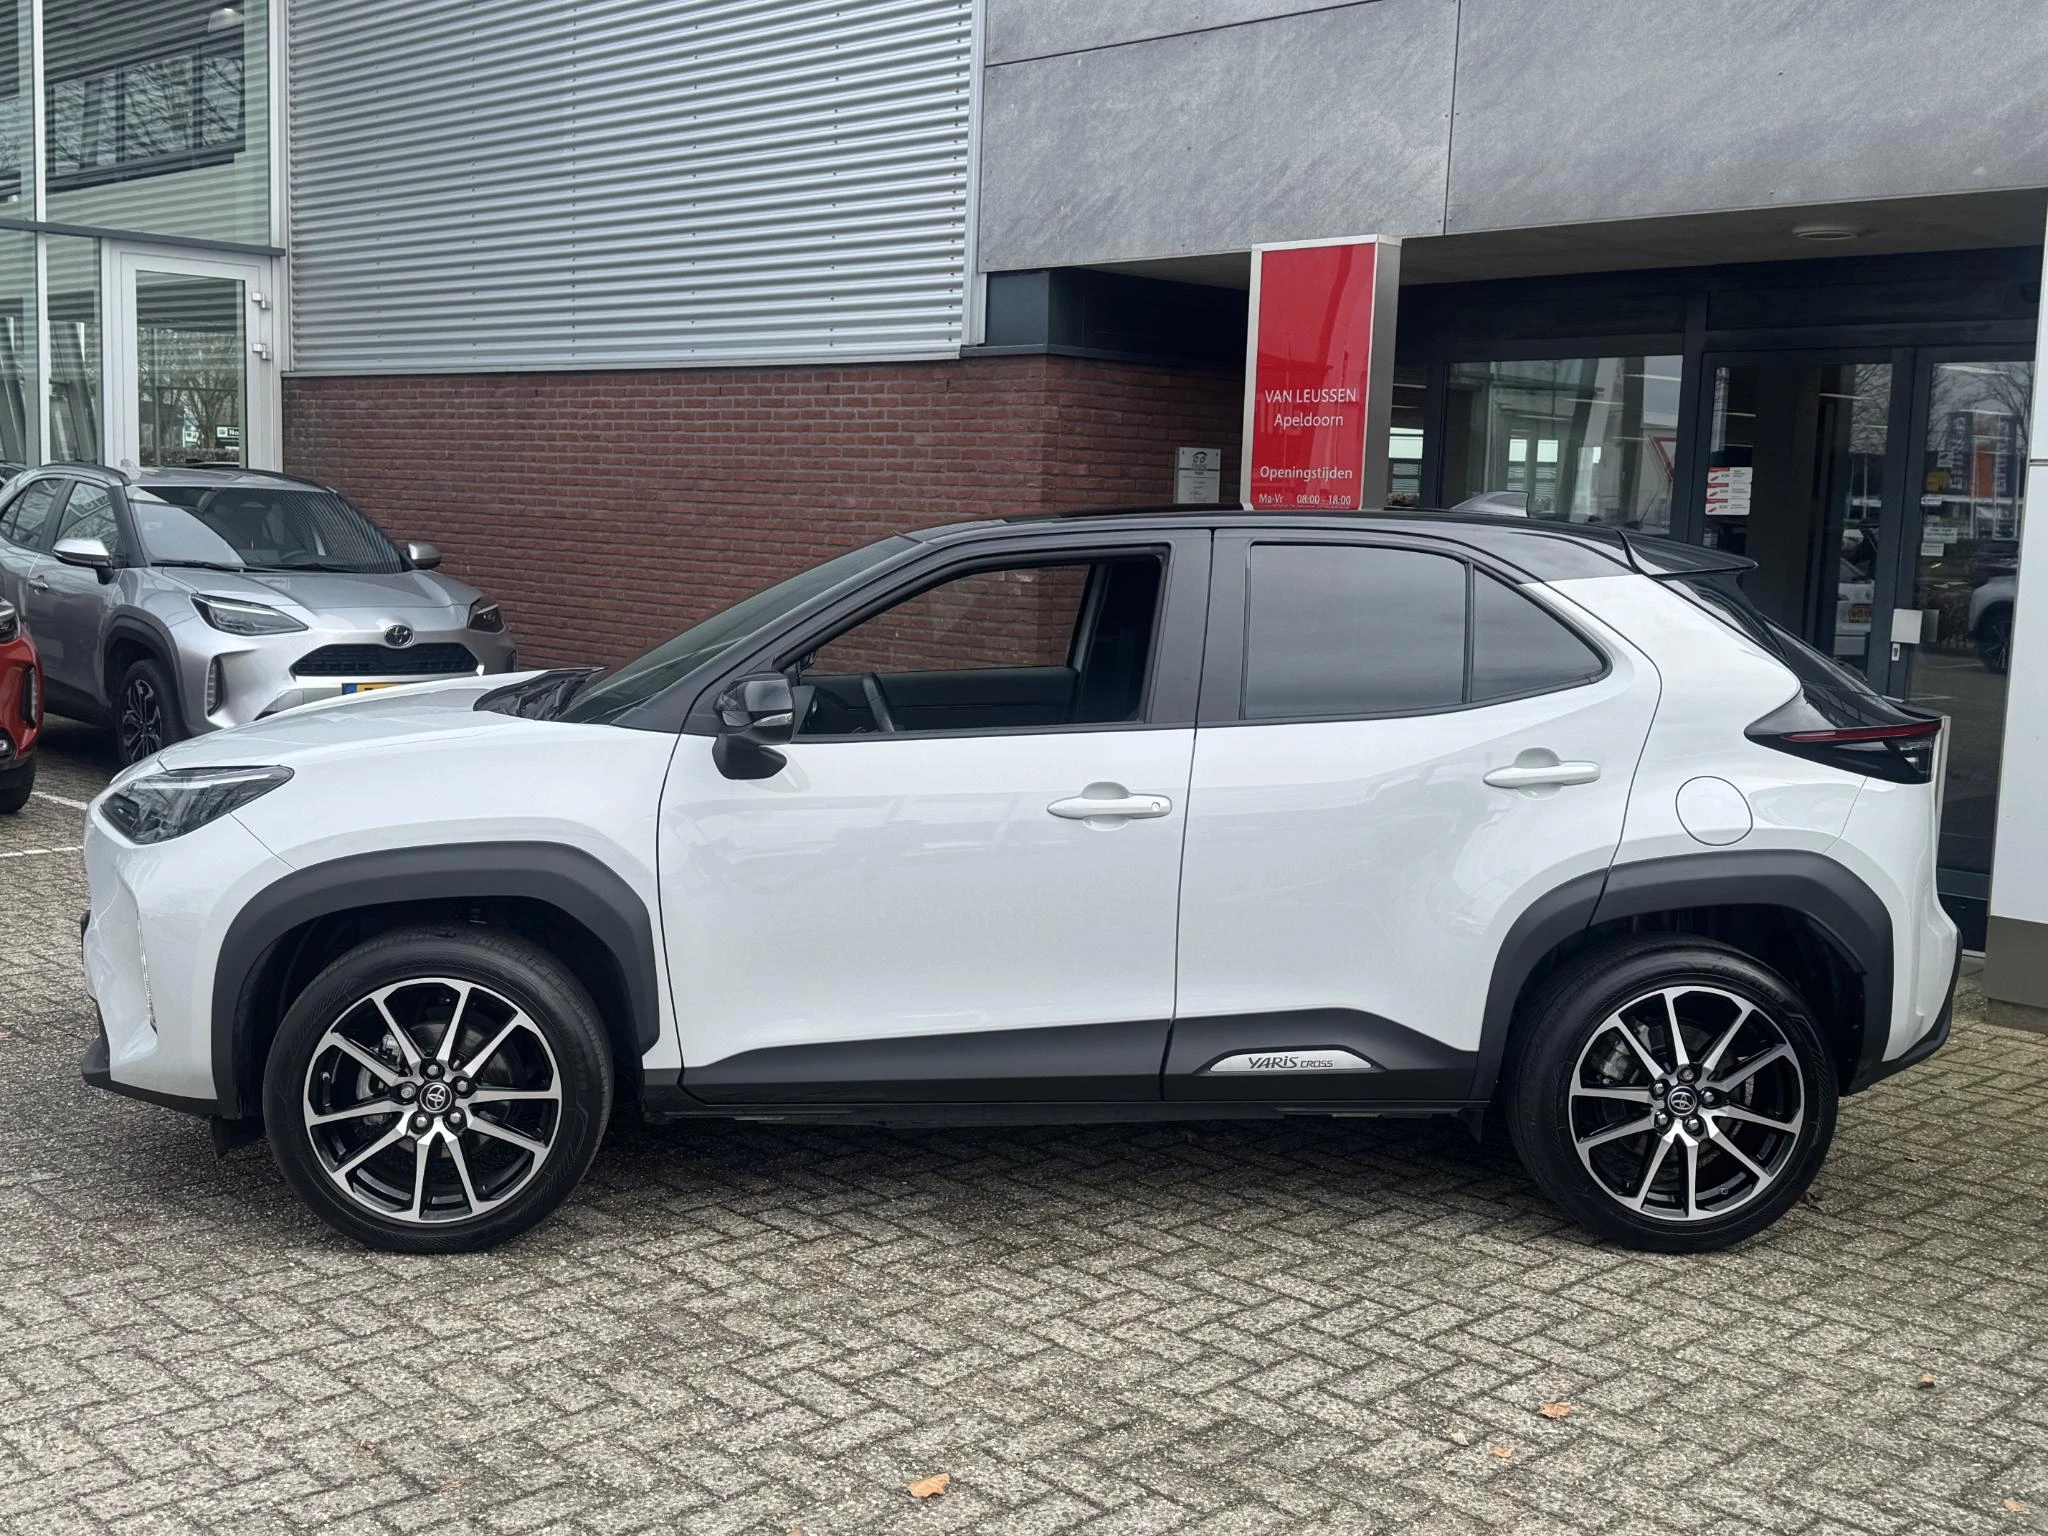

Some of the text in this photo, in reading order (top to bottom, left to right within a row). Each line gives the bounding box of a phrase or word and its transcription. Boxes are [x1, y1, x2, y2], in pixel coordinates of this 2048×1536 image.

[1265, 388, 1356, 402] VAN LEUSSEN
[1274, 412, 1343, 429] Apeldoorn
[1260, 466, 1352, 481] Openingstijden
[1259, 493, 1284, 504] Ma-Vr
[1296, 494, 1320, 505] 08:00
[1328, 495, 1352, 505] 18:00
[1300, 1060, 1333, 1068] CROSS
